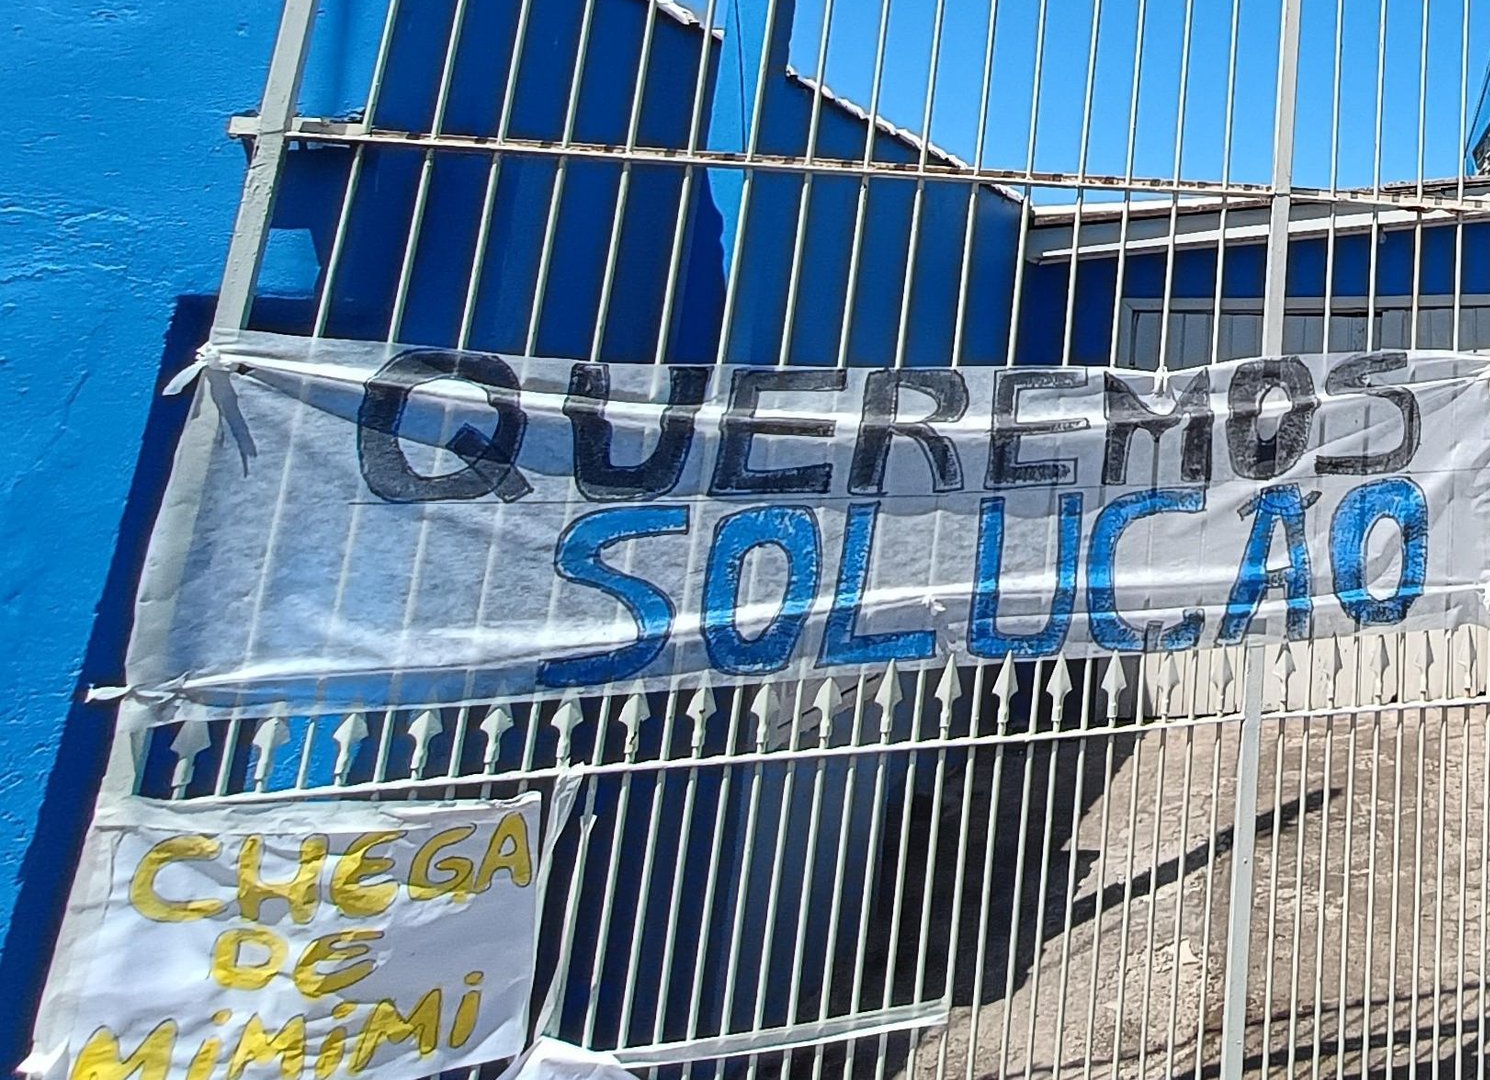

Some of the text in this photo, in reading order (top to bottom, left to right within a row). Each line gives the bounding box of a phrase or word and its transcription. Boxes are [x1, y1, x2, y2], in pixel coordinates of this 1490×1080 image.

[358, 348, 1421, 503] QUEREMOS
[129, 812, 533, 924] CHEGA
[211, 927, 385, 999] DE
